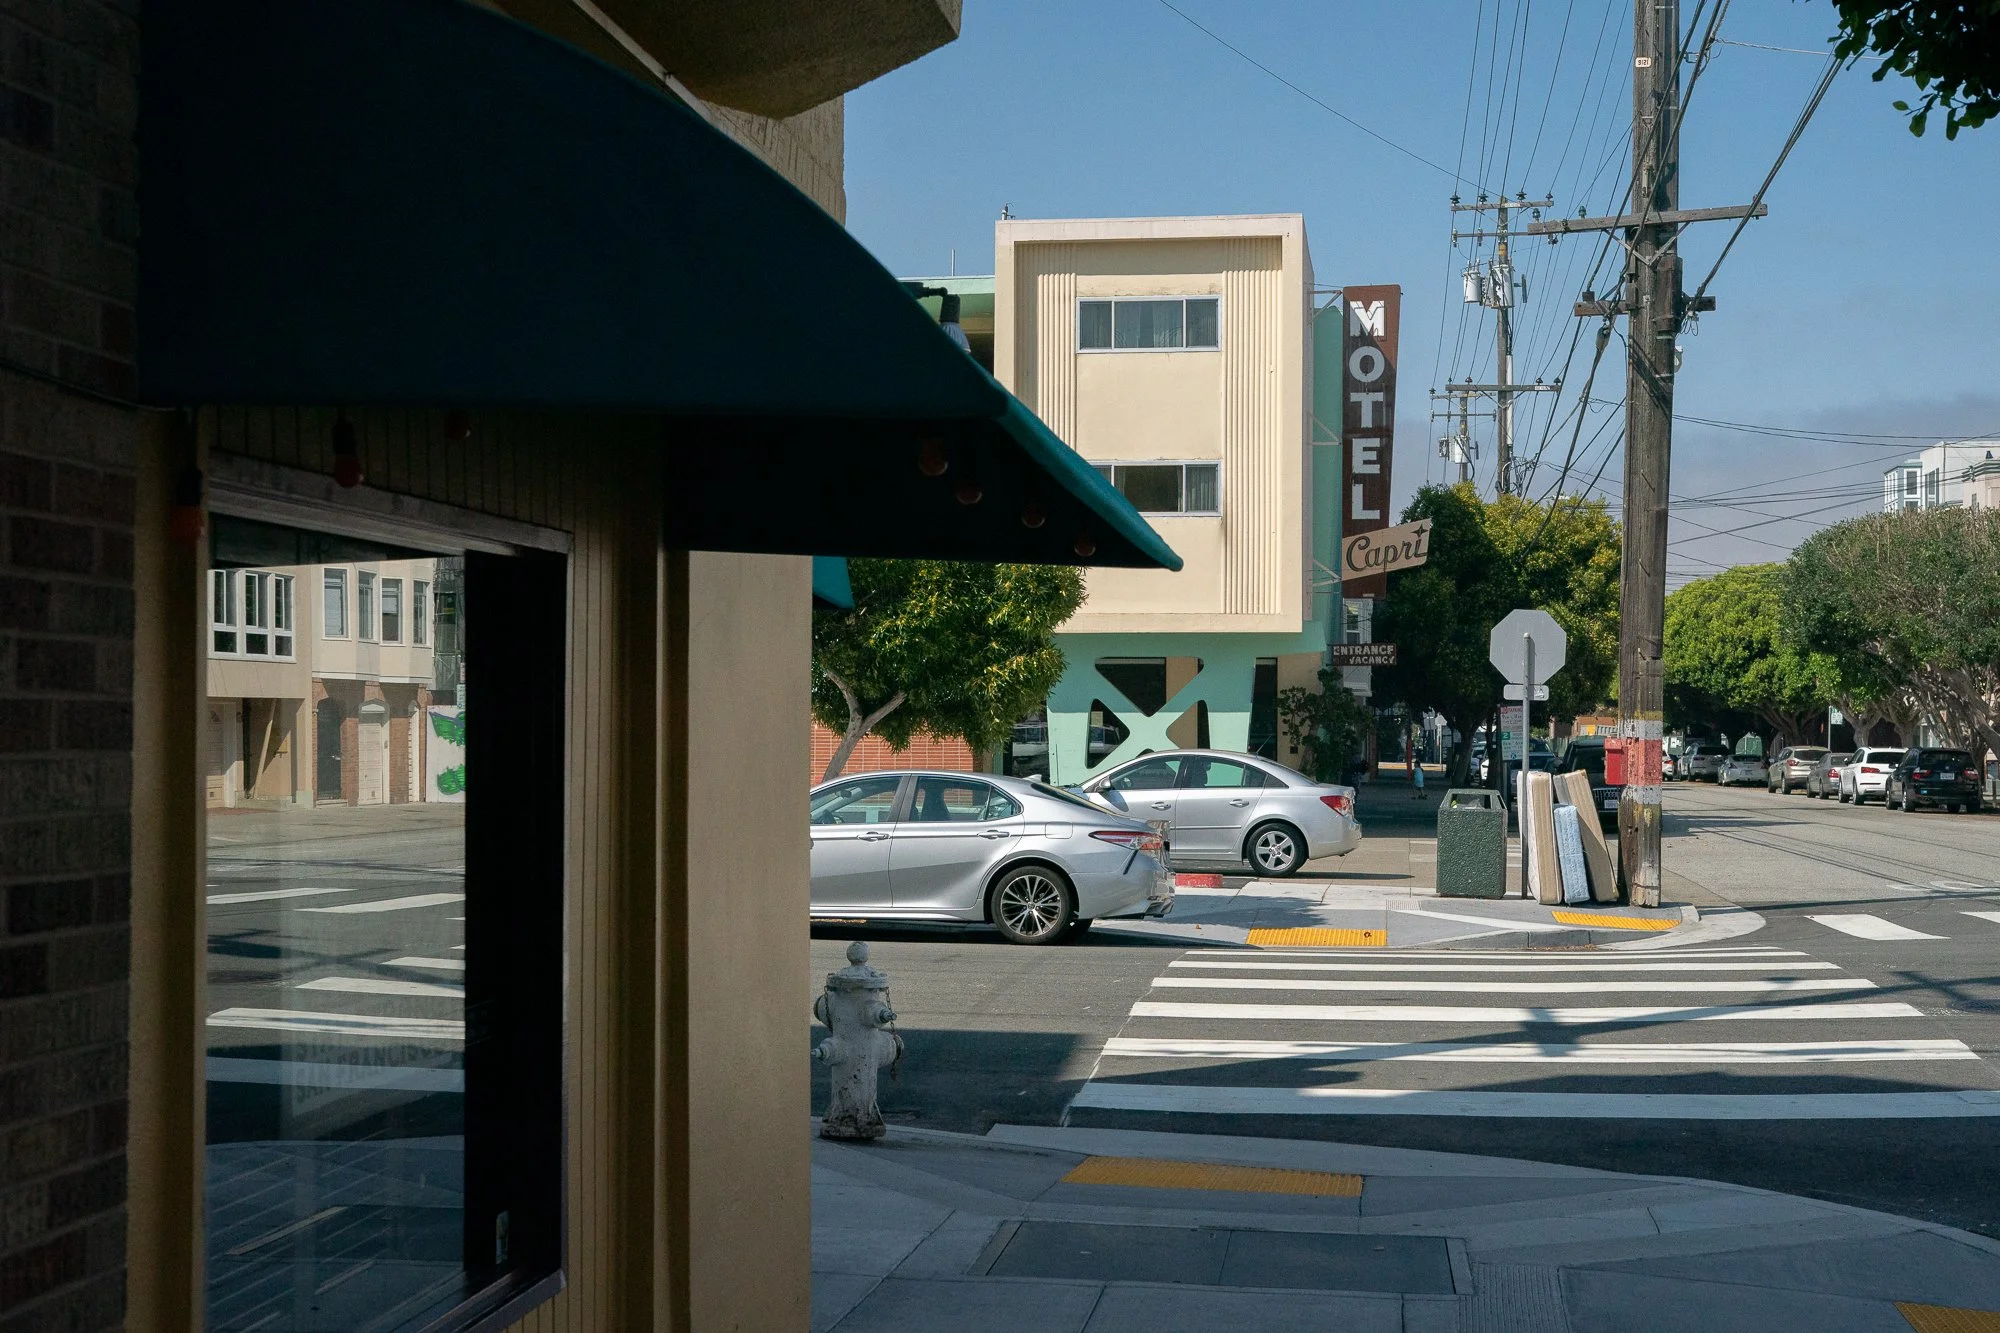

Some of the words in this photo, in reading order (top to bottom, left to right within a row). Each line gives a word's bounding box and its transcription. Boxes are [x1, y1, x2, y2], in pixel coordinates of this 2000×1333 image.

[1349, 300, 1385, 520] MOTEL
[1346, 525, 1428, 572] Capri
[1333, 645, 1394, 655] ENTRANCE
[1349, 656, 1394, 664] VACANCY
